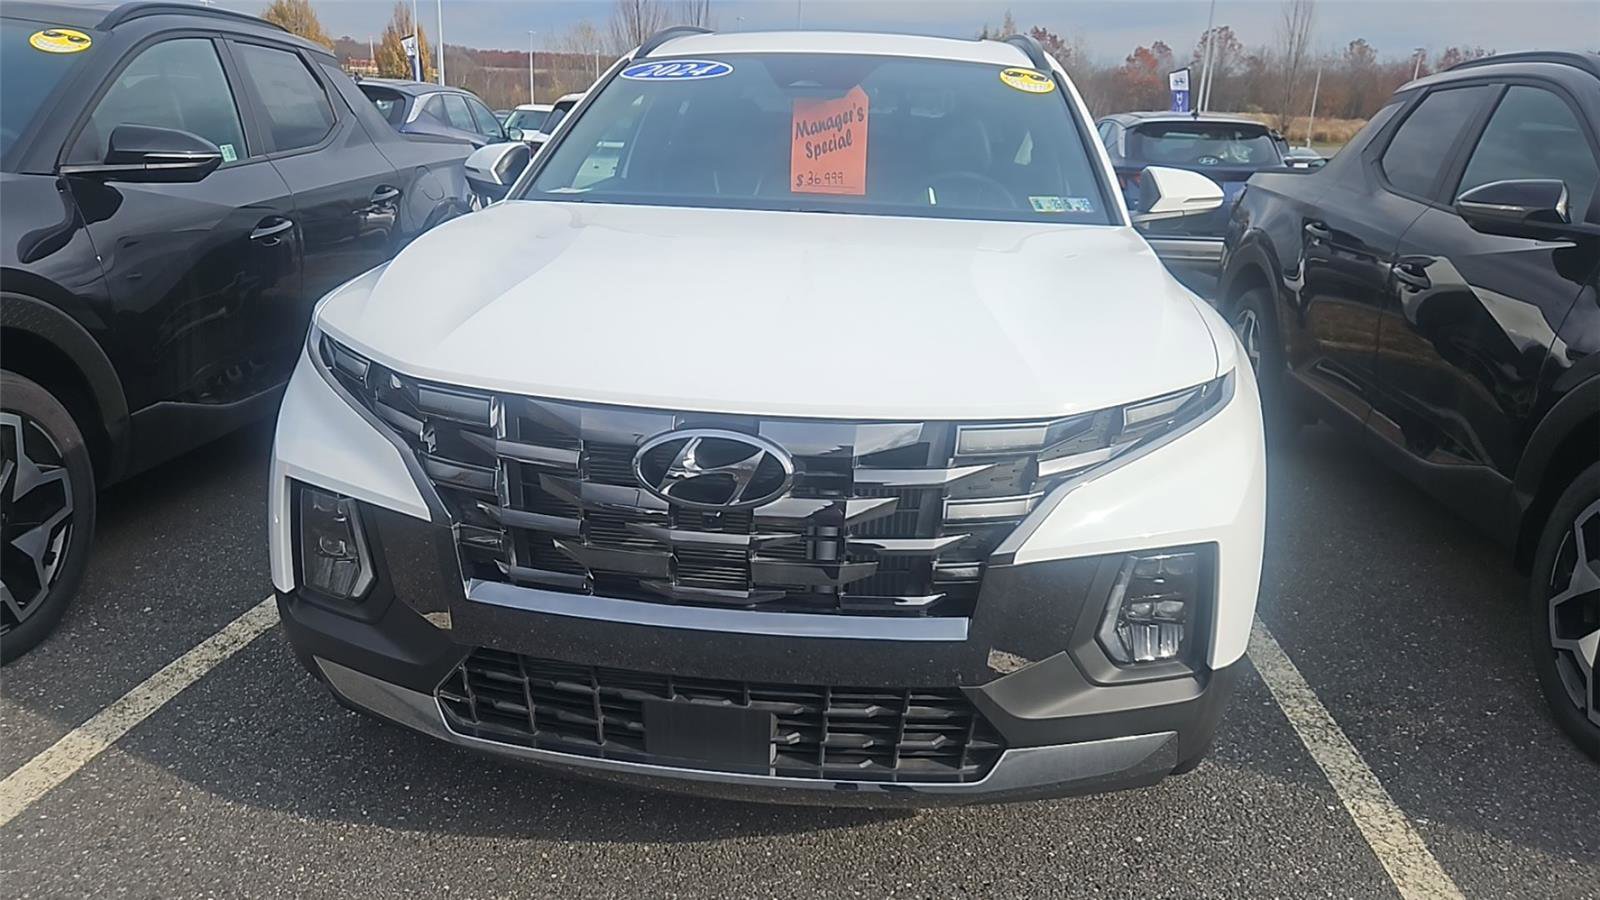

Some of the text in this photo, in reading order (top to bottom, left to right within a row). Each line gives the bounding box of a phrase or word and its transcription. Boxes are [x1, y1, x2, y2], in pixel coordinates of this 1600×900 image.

[634, 64, 720, 77] 2024
[795, 103, 864, 140] Manager's
[805, 128, 853, 160] Special
